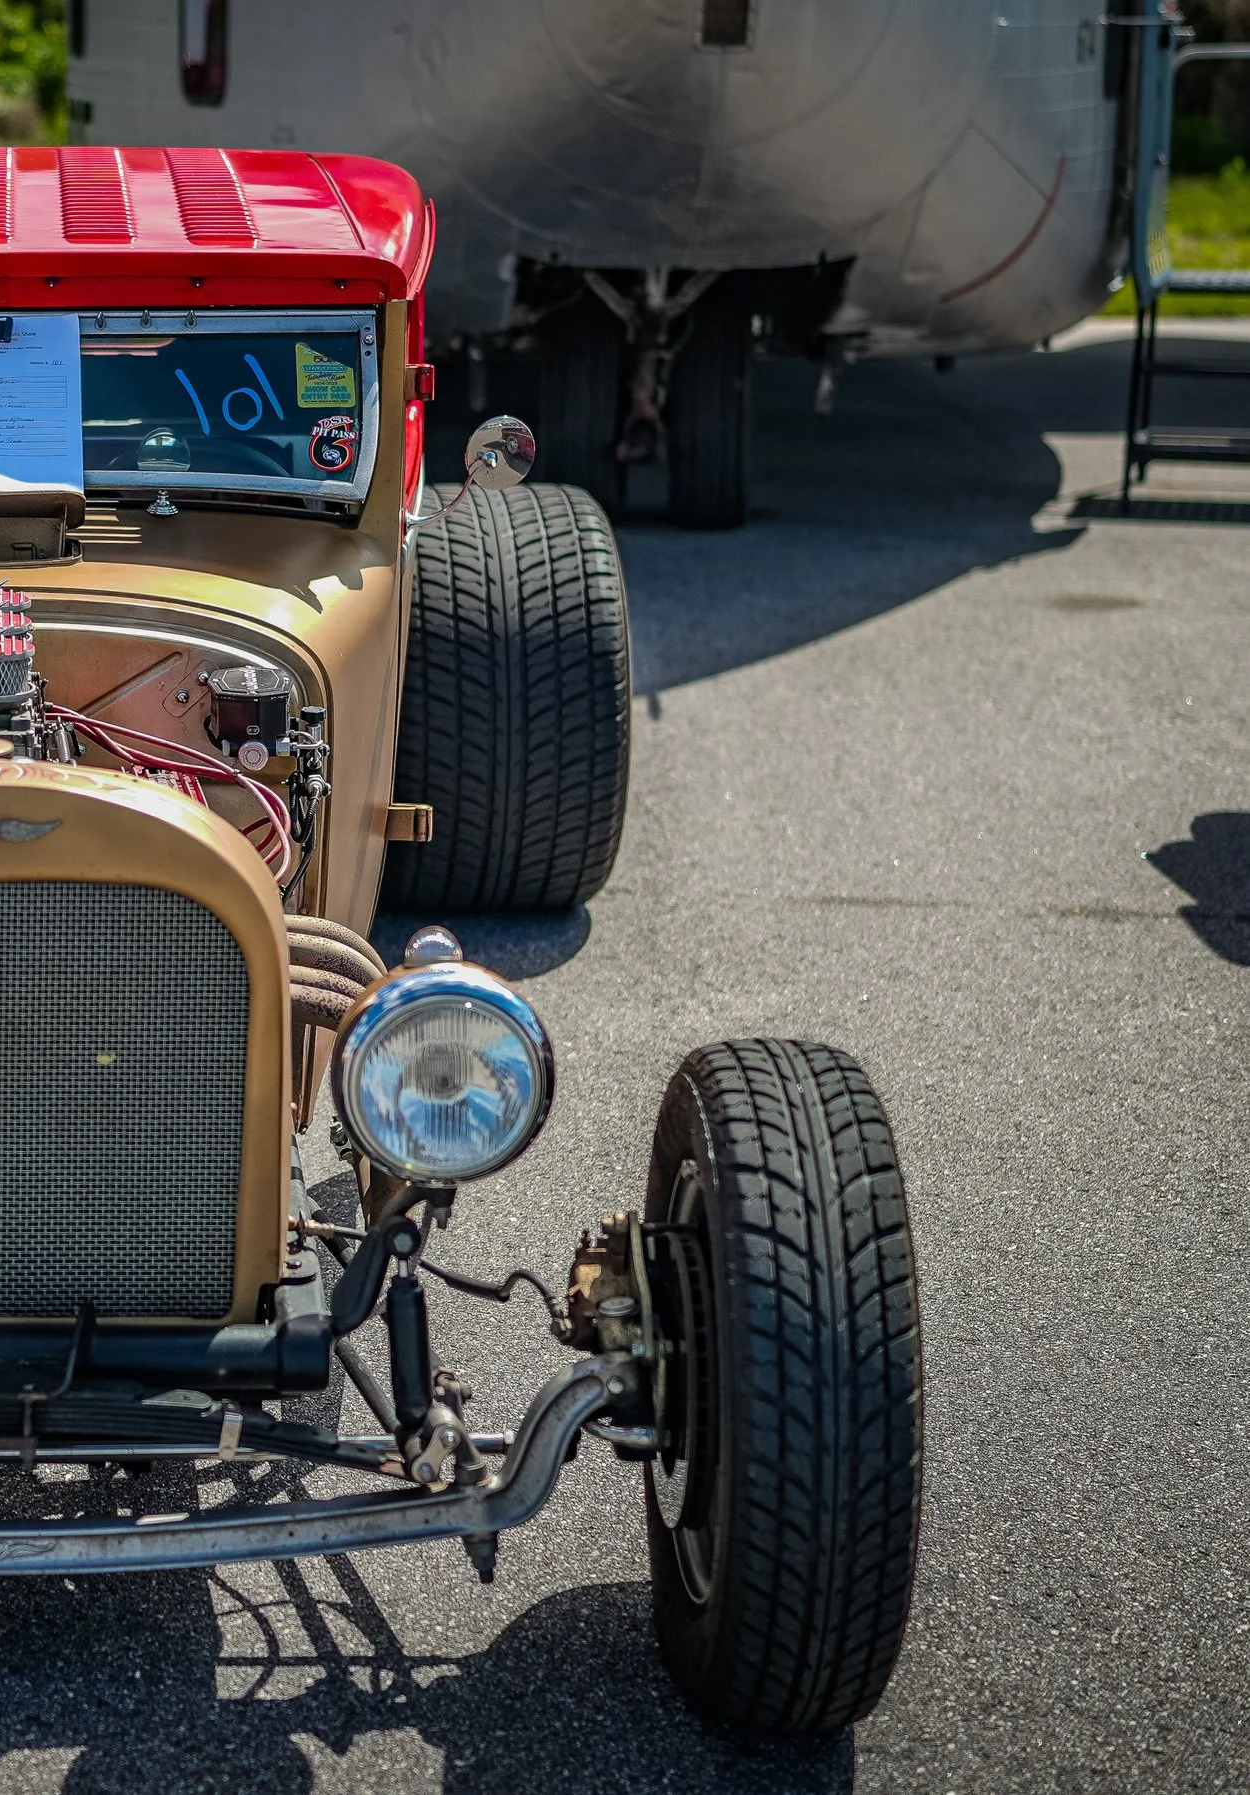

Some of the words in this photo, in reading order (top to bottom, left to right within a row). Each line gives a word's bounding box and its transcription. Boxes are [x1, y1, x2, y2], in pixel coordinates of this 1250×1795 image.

[318, 415, 354, 429] DSR
[311, 426, 329, 436] PIT
[330, 429, 356, 439] PASS
